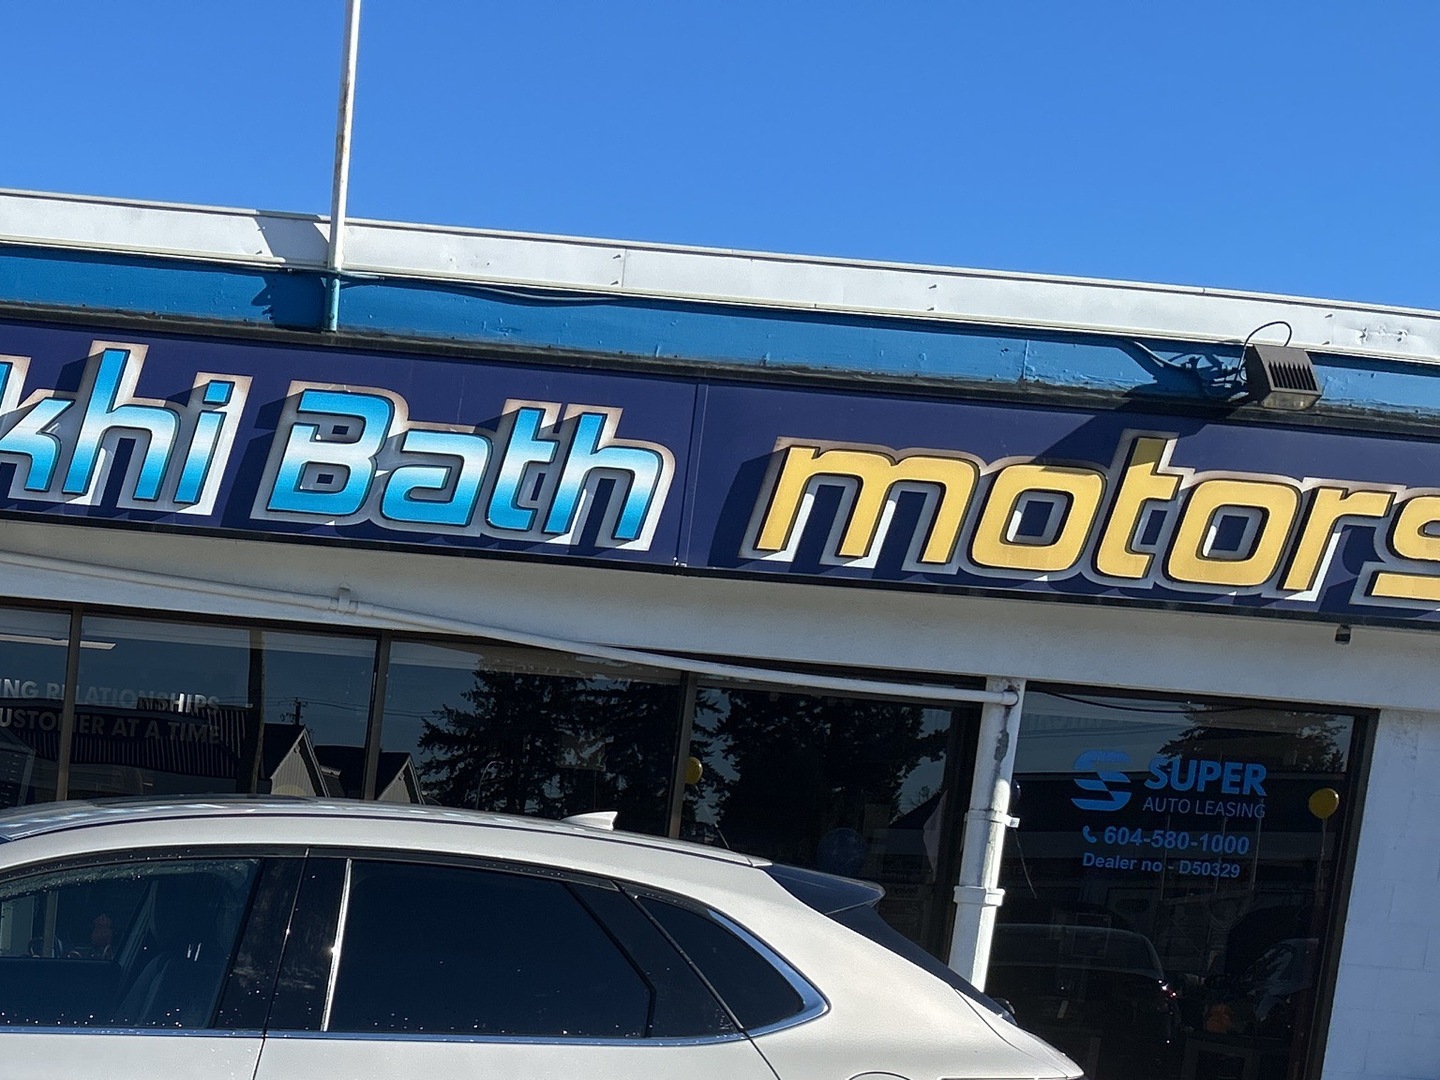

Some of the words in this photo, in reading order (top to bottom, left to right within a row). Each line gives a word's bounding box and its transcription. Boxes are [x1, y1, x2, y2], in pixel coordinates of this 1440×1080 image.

[260, 385, 668, 544] Bath
[46, 682, 220, 716] RLATIONSHIPS
[111, 718, 140, 738] AT
[144, 720, 160, 740] A
[168, 721, 220, 744] TIME
[1144, 755, 1267, 797] SUPER
[1142, 797, 1191, 814] AUTO
[1195, 800, 1266, 819] LEASING
[1104, 826, 1250, 855] 604-580-1000
[1082, 852, 1137, 871] Dealer
[1141, 860, 1163, 873] no
[1179, 860, 1241, 878] D50329
